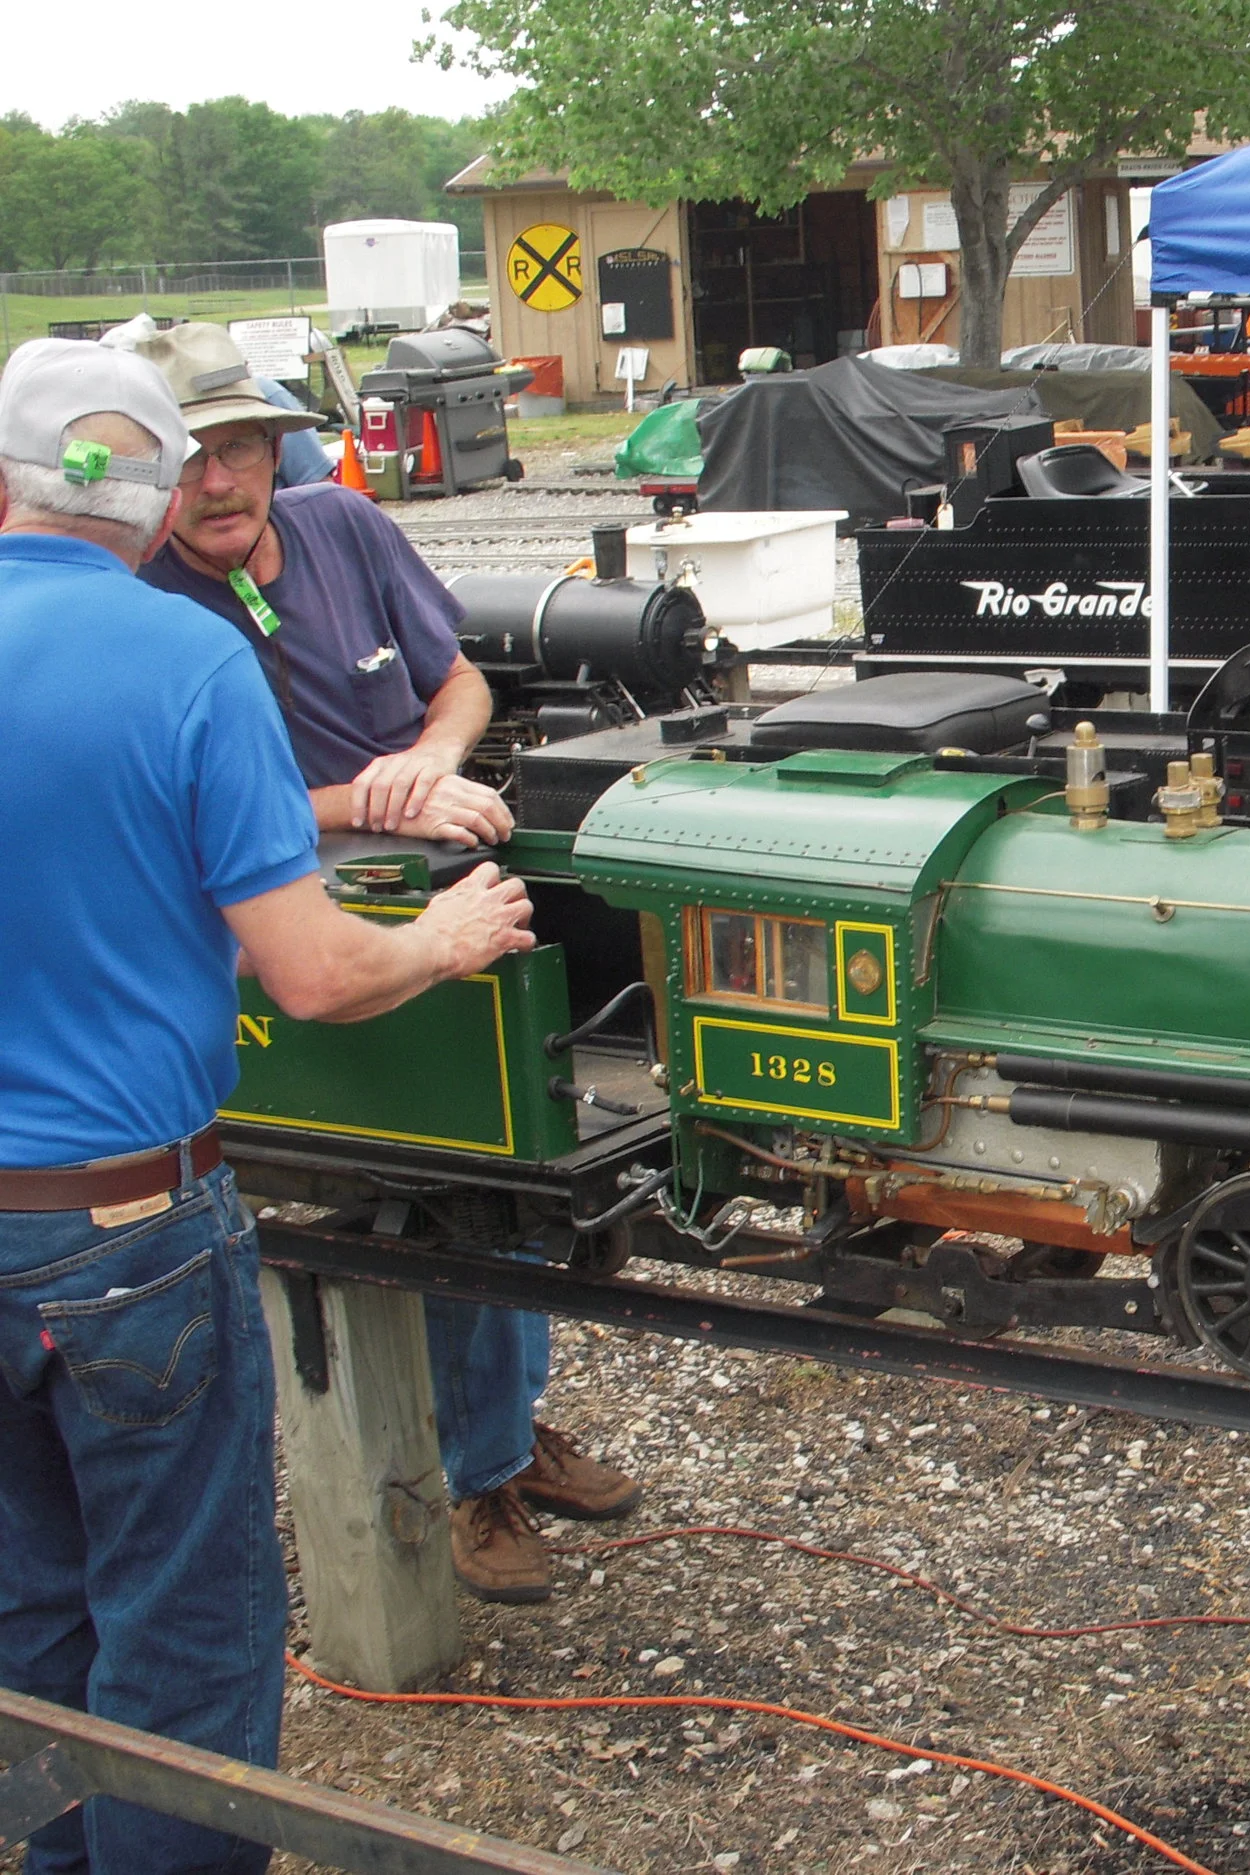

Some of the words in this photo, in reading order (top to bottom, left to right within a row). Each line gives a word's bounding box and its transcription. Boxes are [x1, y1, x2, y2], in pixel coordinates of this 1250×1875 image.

[513, 259, 530, 281] R
[566, 255, 582, 277] R
[246, 320, 270, 329] SAFETY
[272, 319, 293, 328] RULES
[959, 581, 1030, 617] Rio
[1027, 581, 1153, 617] Grande
[751, 1052, 836, 1087] 1328
